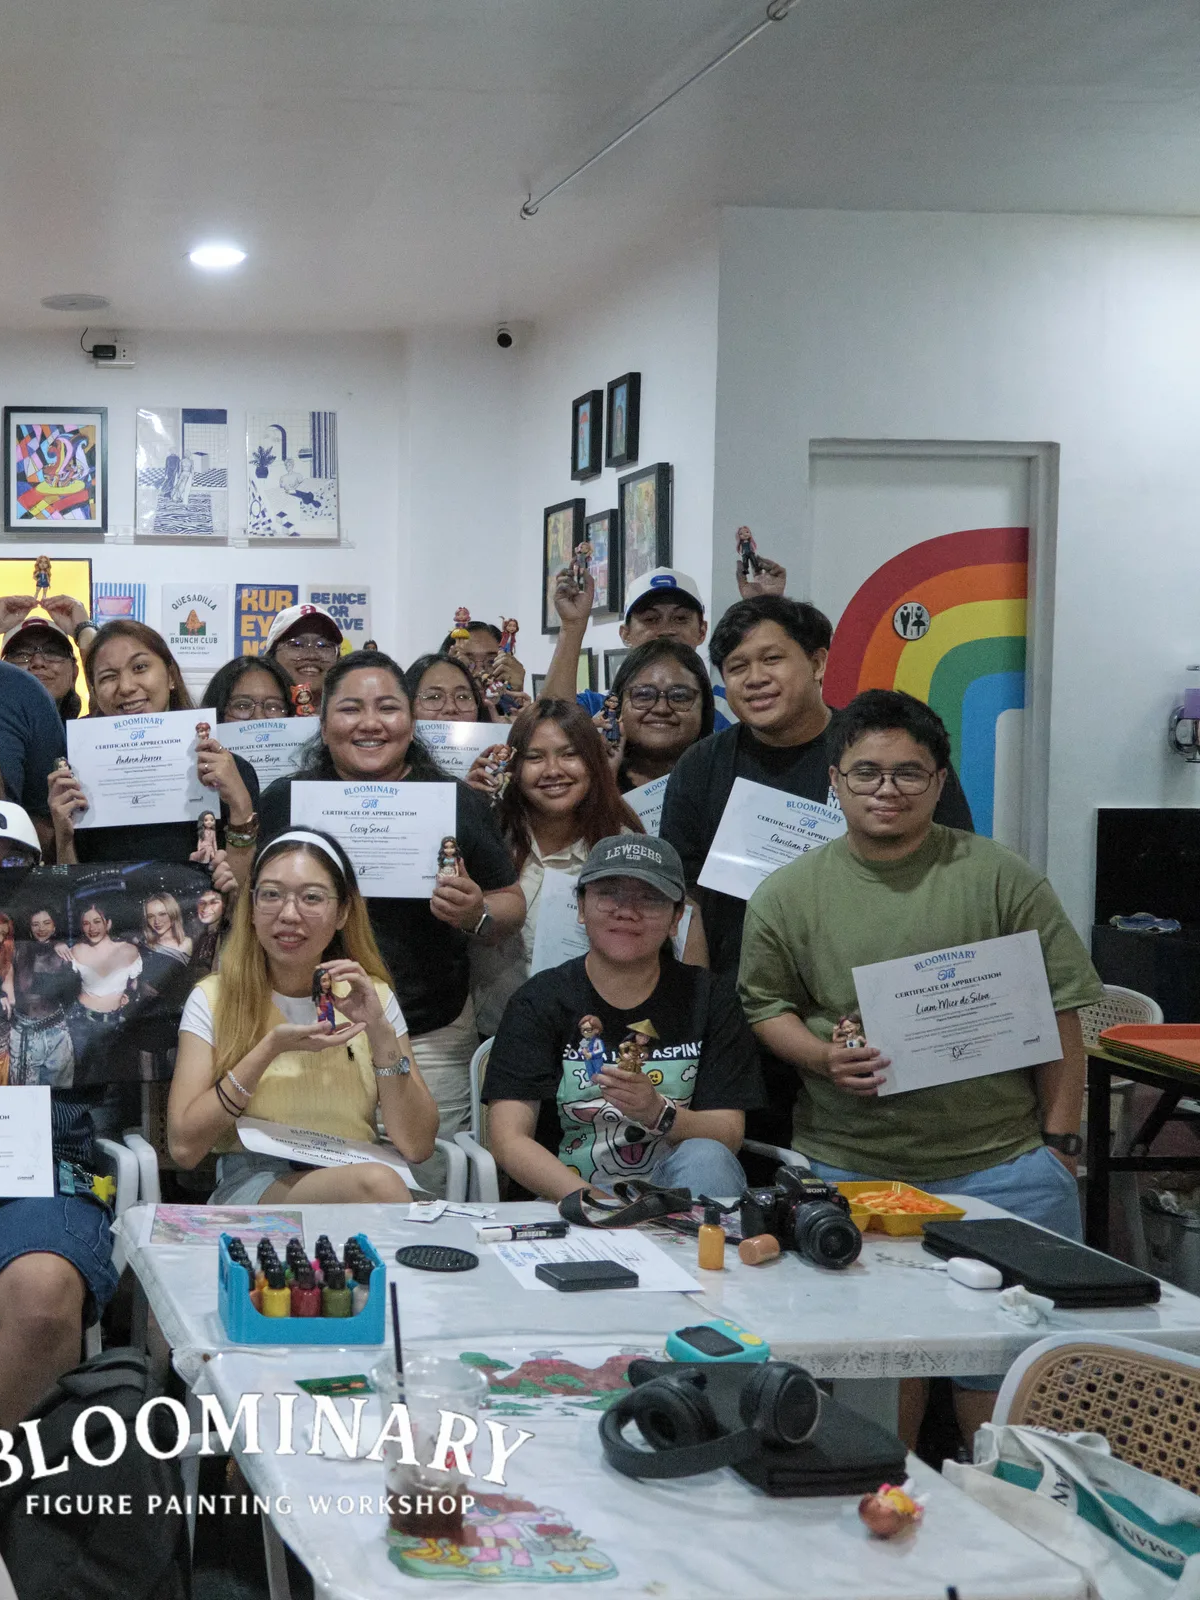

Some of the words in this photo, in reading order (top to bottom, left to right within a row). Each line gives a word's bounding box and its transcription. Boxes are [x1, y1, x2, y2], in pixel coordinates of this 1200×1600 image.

[171, 594, 218, 610] QUESADILLA
[311, 592, 330, 604] BE
[332, 592, 366, 604] NICE
[327, 605, 349, 617] OR
[113, 717, 164, 729] BLOOMINARY
[239, 722, 288, 733] BLOOMINARY
[95, 742, 130, 750] CERTIFICATE
[140, 738, 181, 746] APPRECIATION
[344, 785, 400, 796] BLOOMINARY
[786, 800, 843, 823] BLOOMINARY
[757, 814, 796, 832] CERTIFICATE
[605, 843, 662, 864] LEWSERS
[914, 950, 977, 971] BLOOMINARY
[895, 985, 938, 999] CERTIFICATE
[940, 982, 950, 990] OF
[952, 971, 1001, 987] APPRECIATION
[290, 1128, 346, 1144] BLOOMINARY
